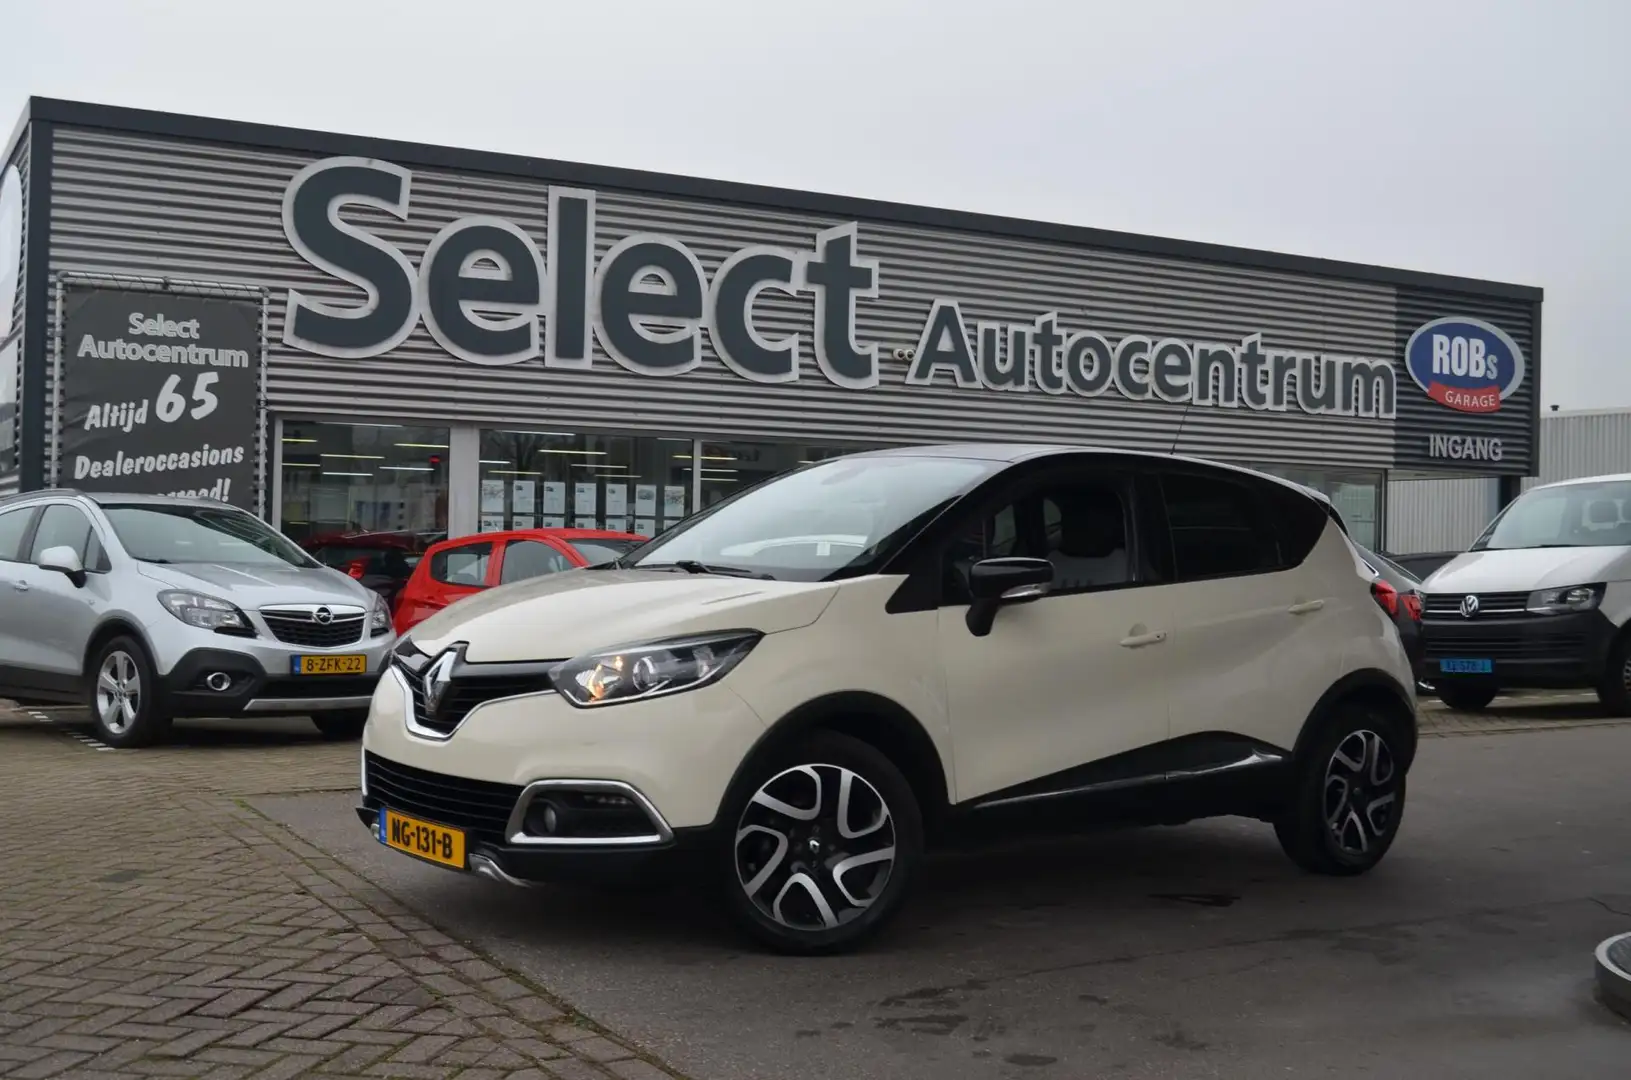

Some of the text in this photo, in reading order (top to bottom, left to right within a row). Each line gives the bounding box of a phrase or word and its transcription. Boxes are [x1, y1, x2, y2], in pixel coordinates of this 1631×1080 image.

[282, 156, 1398, 419] Select Autocentrum
[128, 312, 200, 340] Select
[77, 334, 249, 368] Autocentrum
[84, 371, 220, 432] Altijd 65
[1445, 390, 1496, 407] GARAGE
[74, 444, 244, 480] Dealeroccasions
[1429, 434, 1503, 461] INGANG
[306, 657, 361, 671] 8-ZFK-22
[392, 817, 453, 859] NG-131-B
